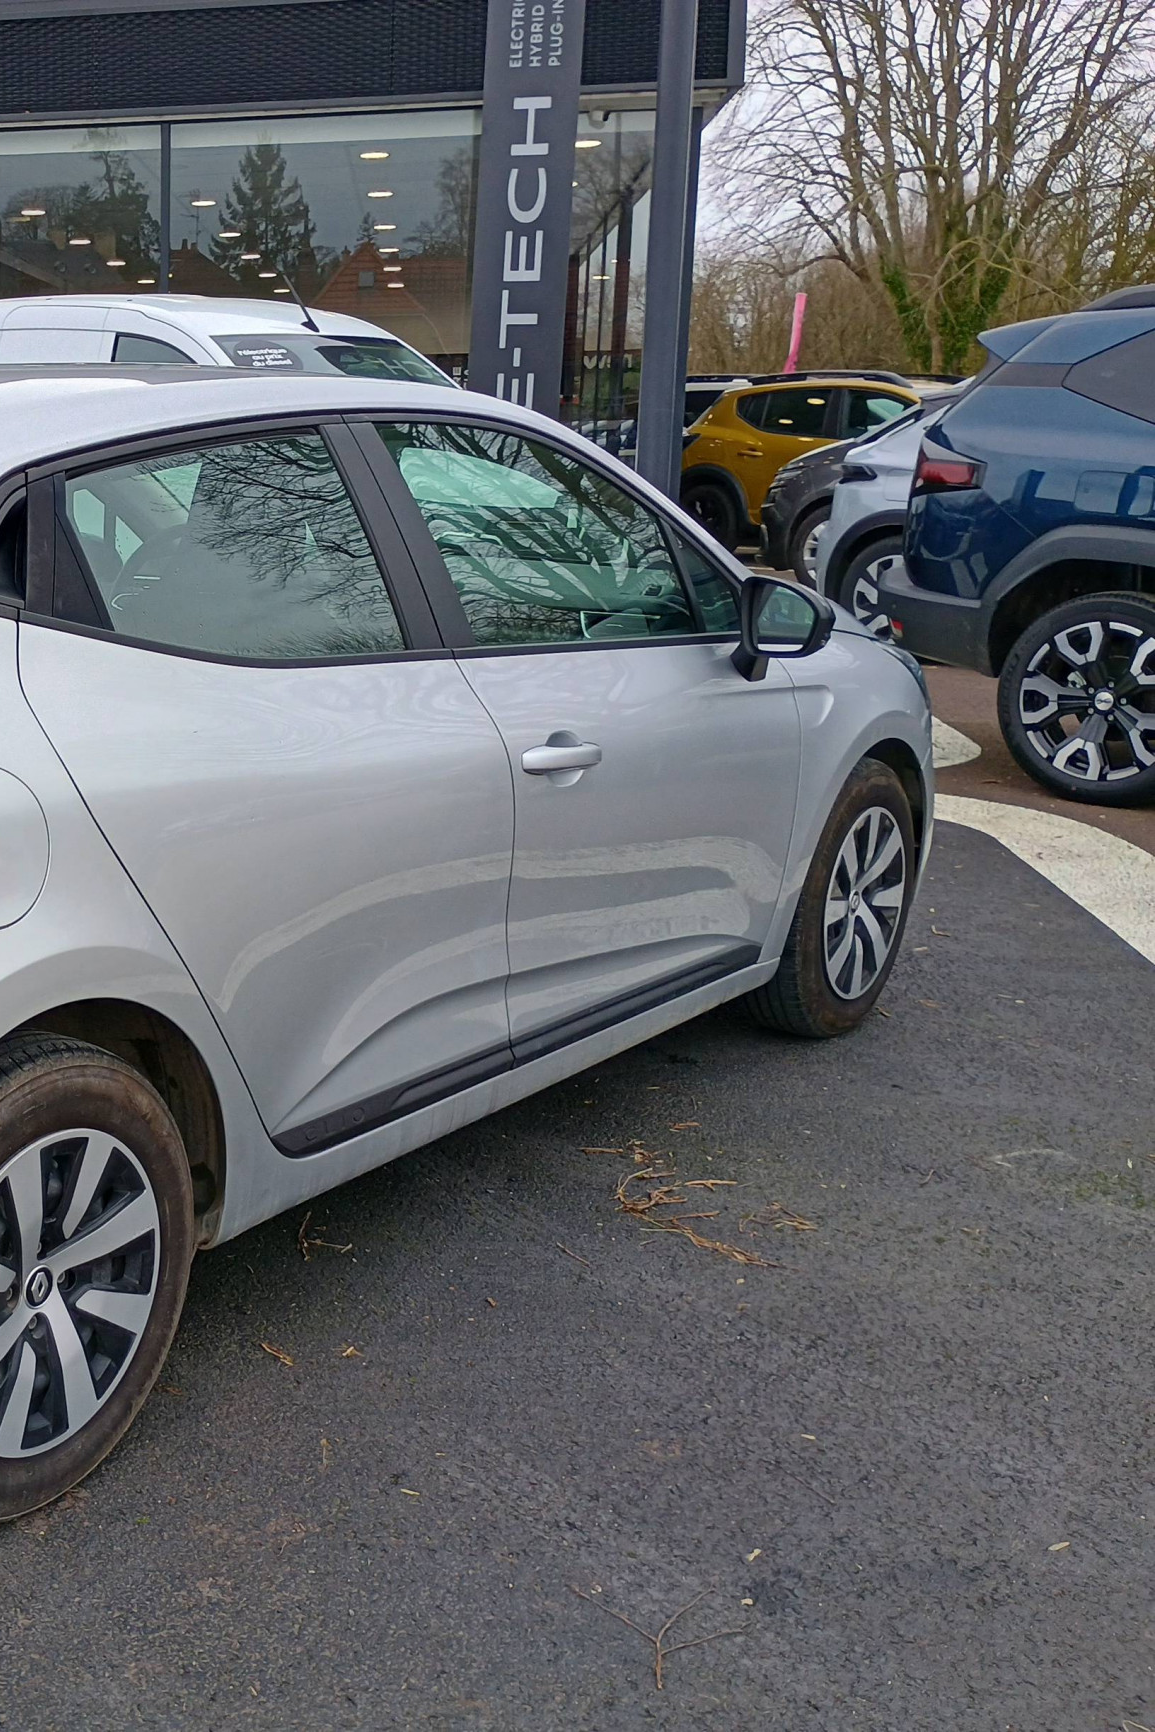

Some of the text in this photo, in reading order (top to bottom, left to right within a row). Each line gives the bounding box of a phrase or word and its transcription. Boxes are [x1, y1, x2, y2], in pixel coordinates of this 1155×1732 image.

[509, 0, 526, 68] ELECTRI
[528, 4, 545, 67] HYBRID
[496, 96, 552, 410] E-TECH
